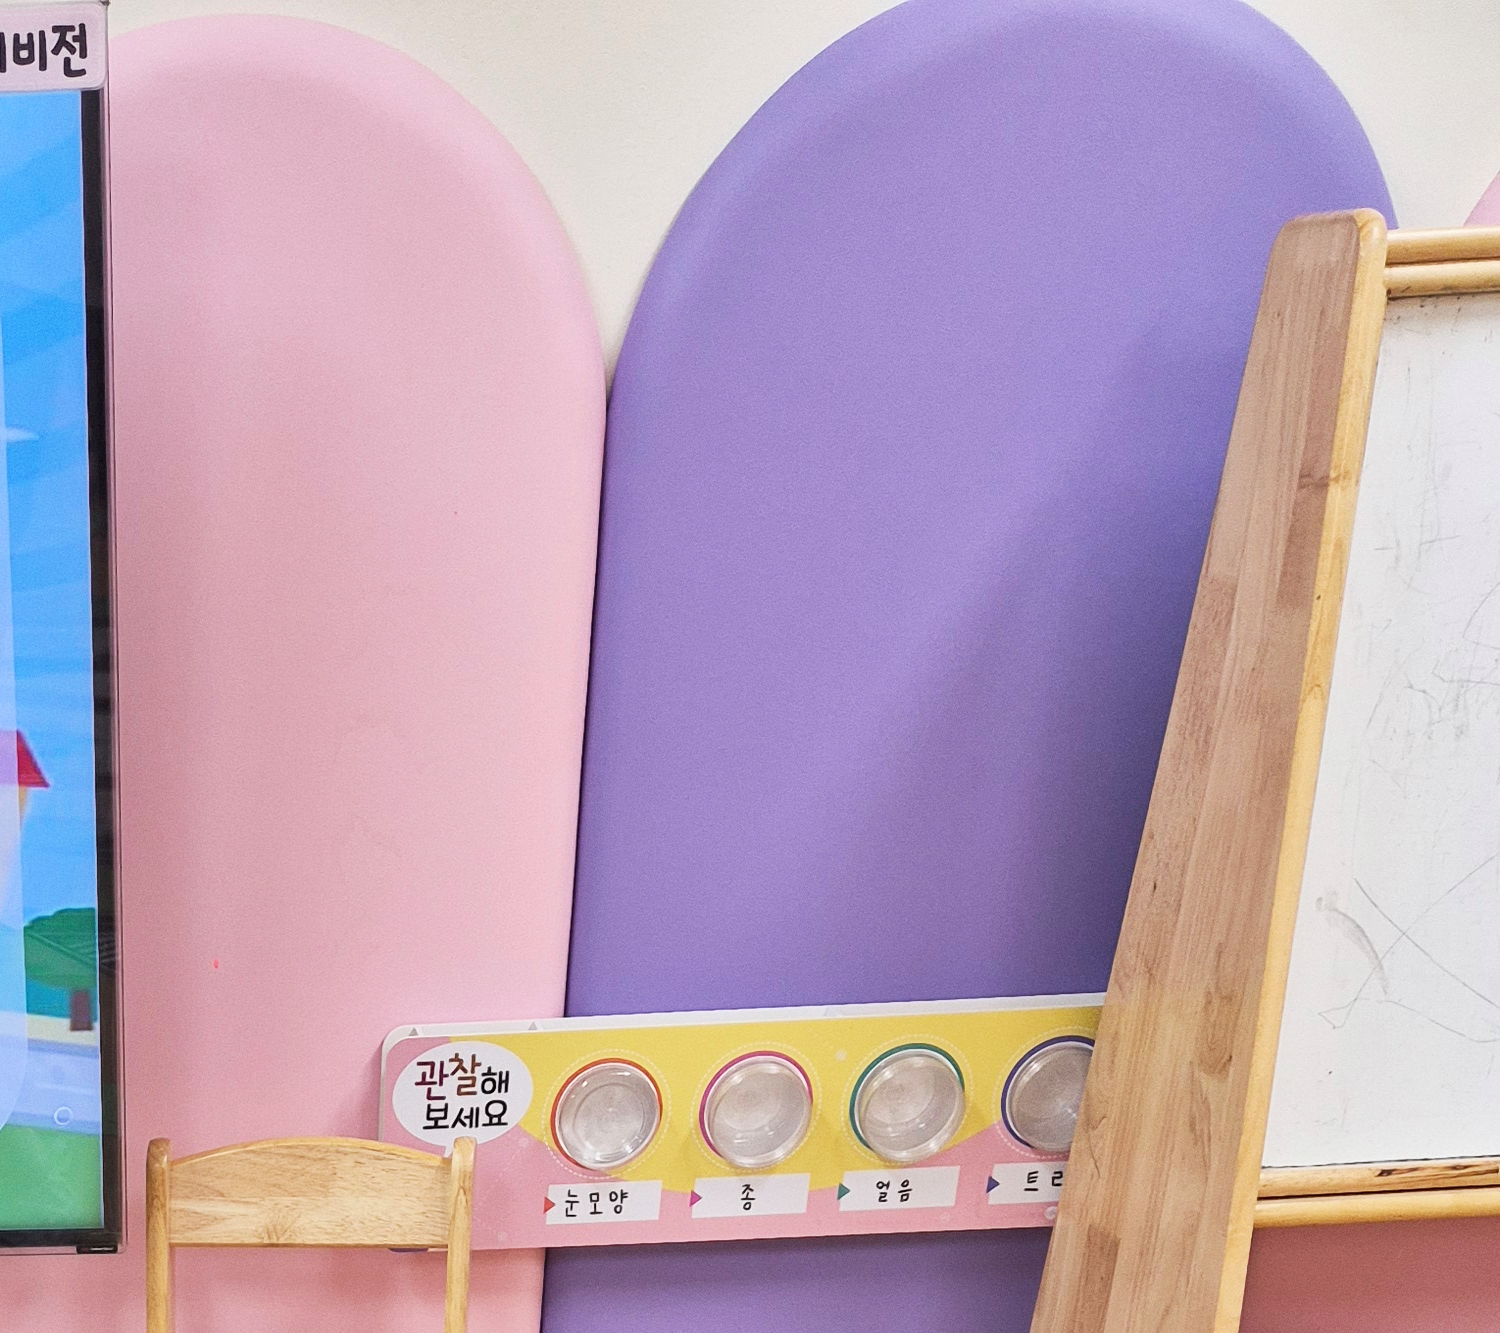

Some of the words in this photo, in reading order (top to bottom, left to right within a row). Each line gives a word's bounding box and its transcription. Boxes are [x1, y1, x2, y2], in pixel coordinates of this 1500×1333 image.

[414, 1052, 510, 1101] 관찰해
[422, 1099, 509, 1130] 보세요
[740, 1183, 756, 1211] 종
[875, 1179, 913, 1203] 얼음
